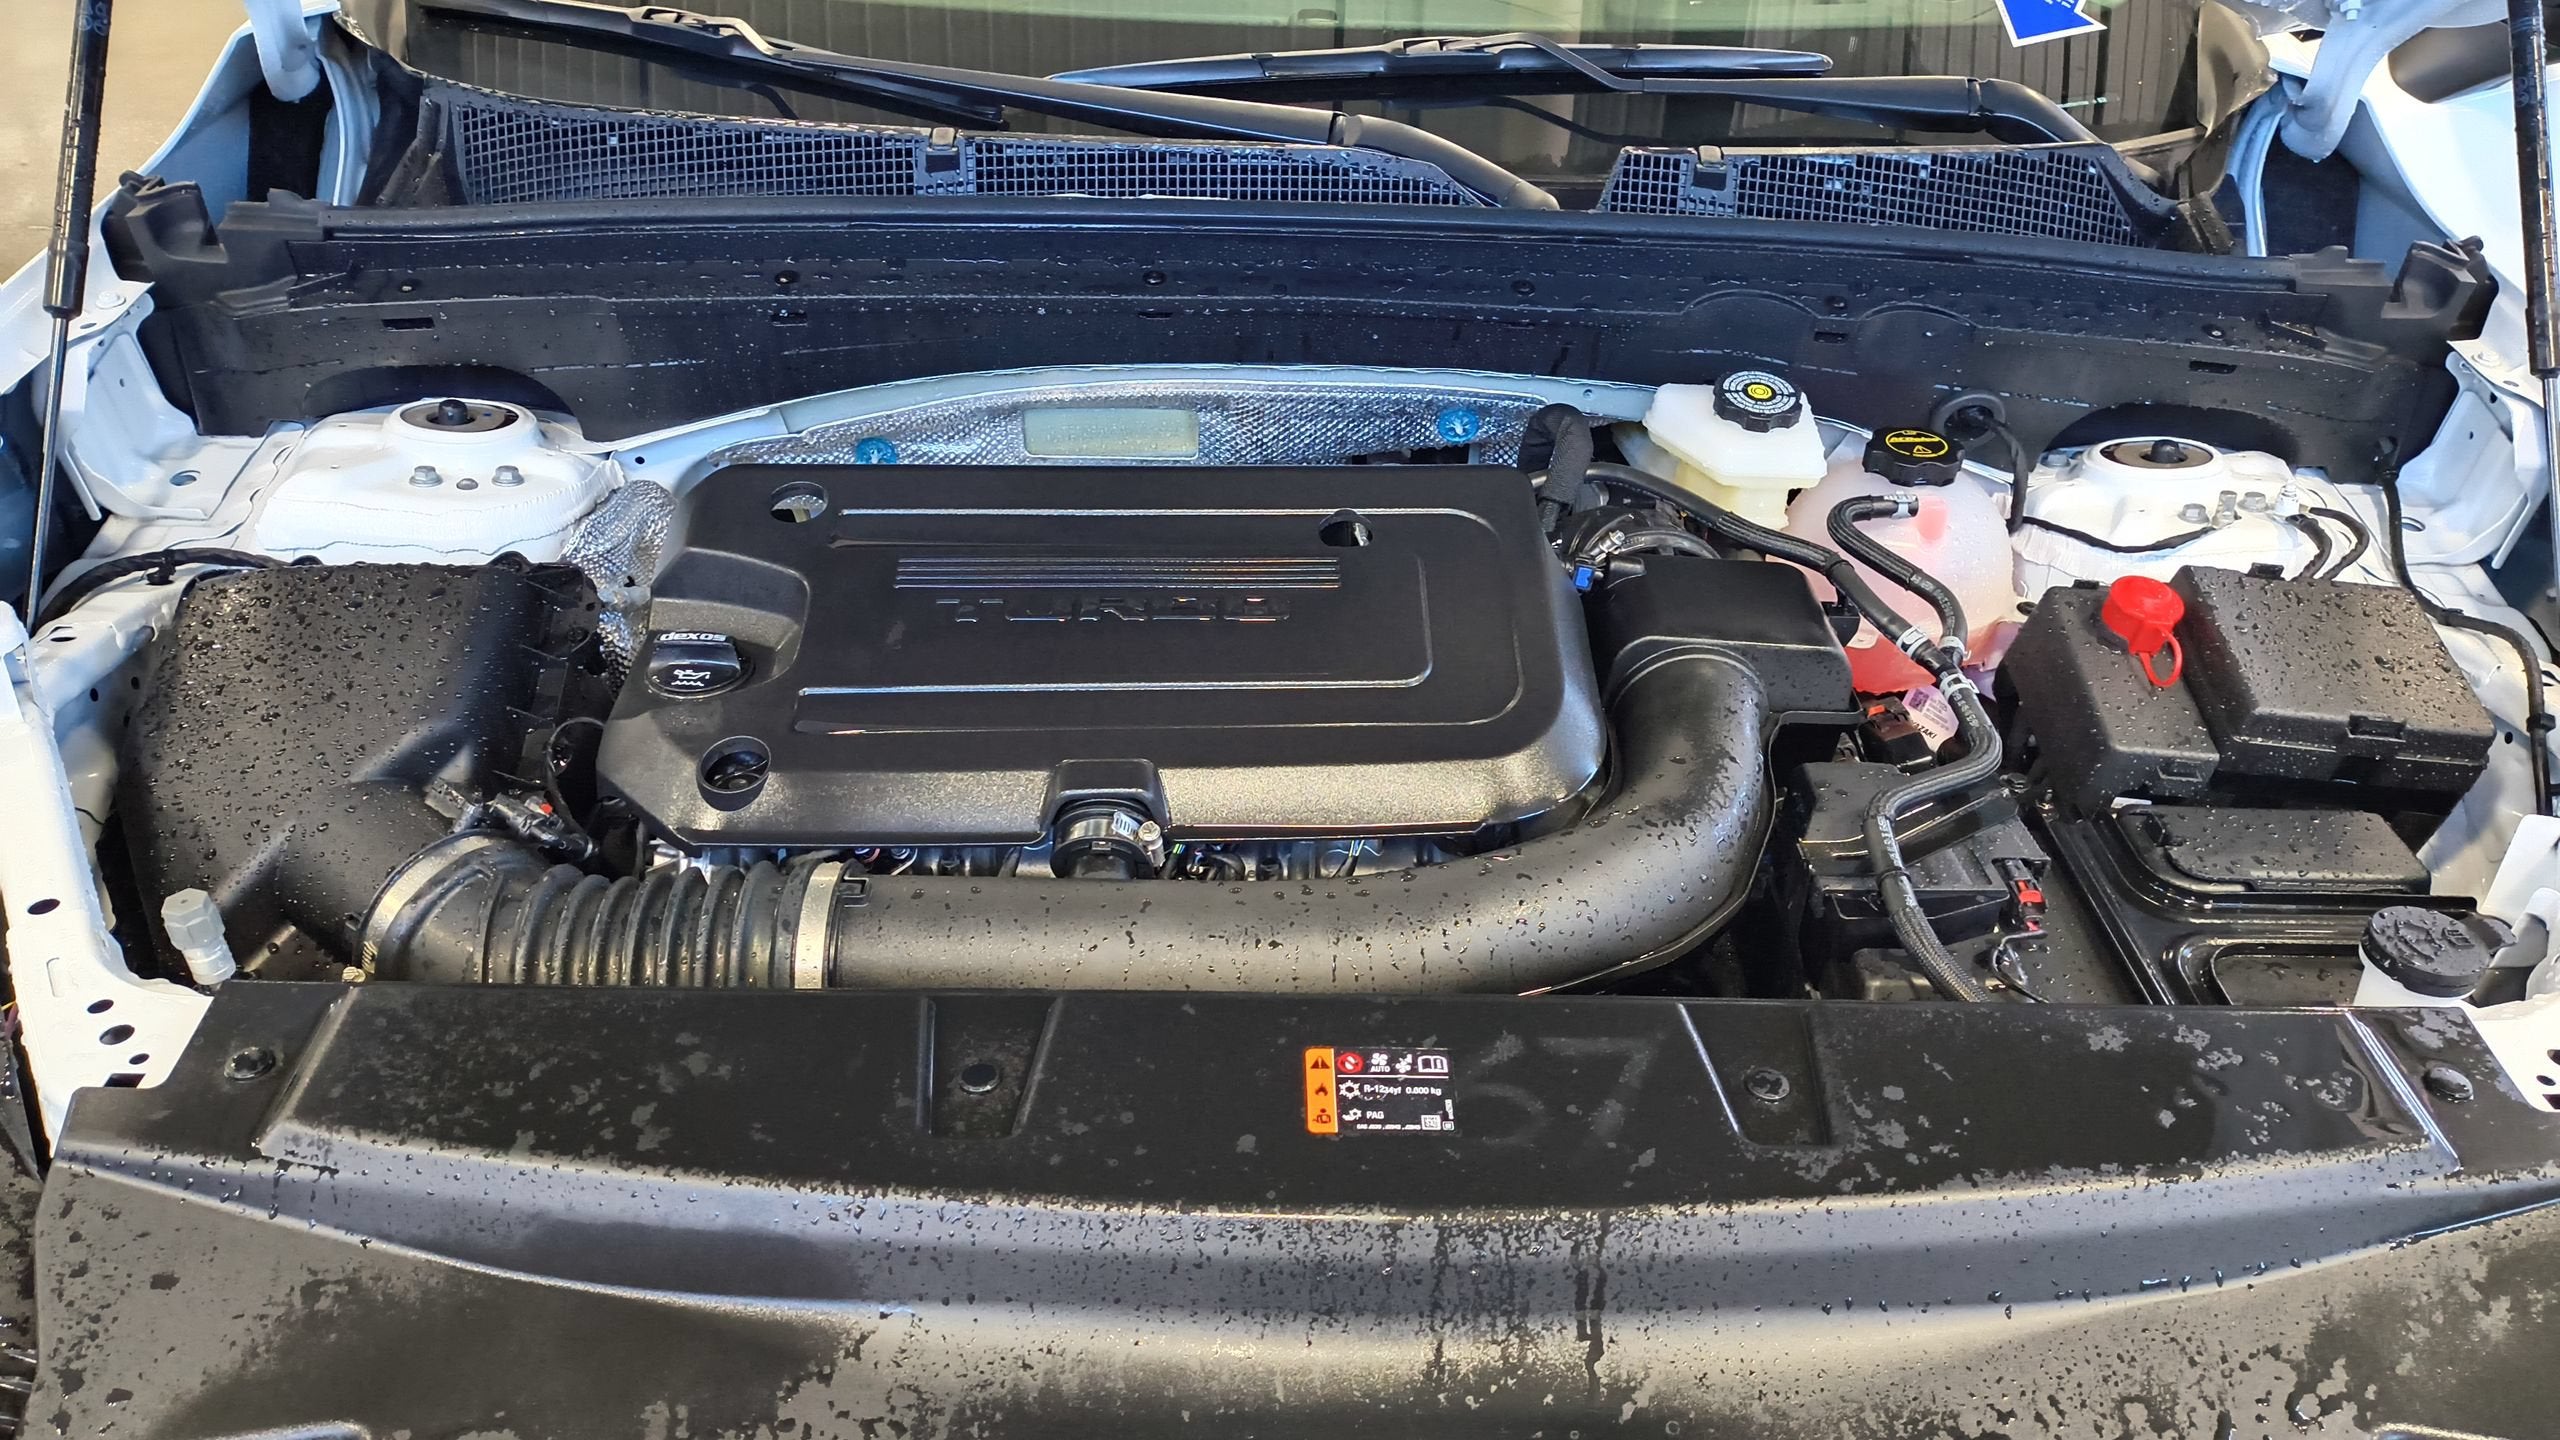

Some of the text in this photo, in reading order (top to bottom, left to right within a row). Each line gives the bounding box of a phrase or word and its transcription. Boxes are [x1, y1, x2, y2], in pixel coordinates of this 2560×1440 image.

[936, 597, 1289, 624] TURBO
[660, 632, 728, 642] dexos
[1364, 1084, 1402, 1096] R-1234yf
[1430, 1087, 1442, 1096] kg
[1366, 1111, 1384, 1119] PAG
